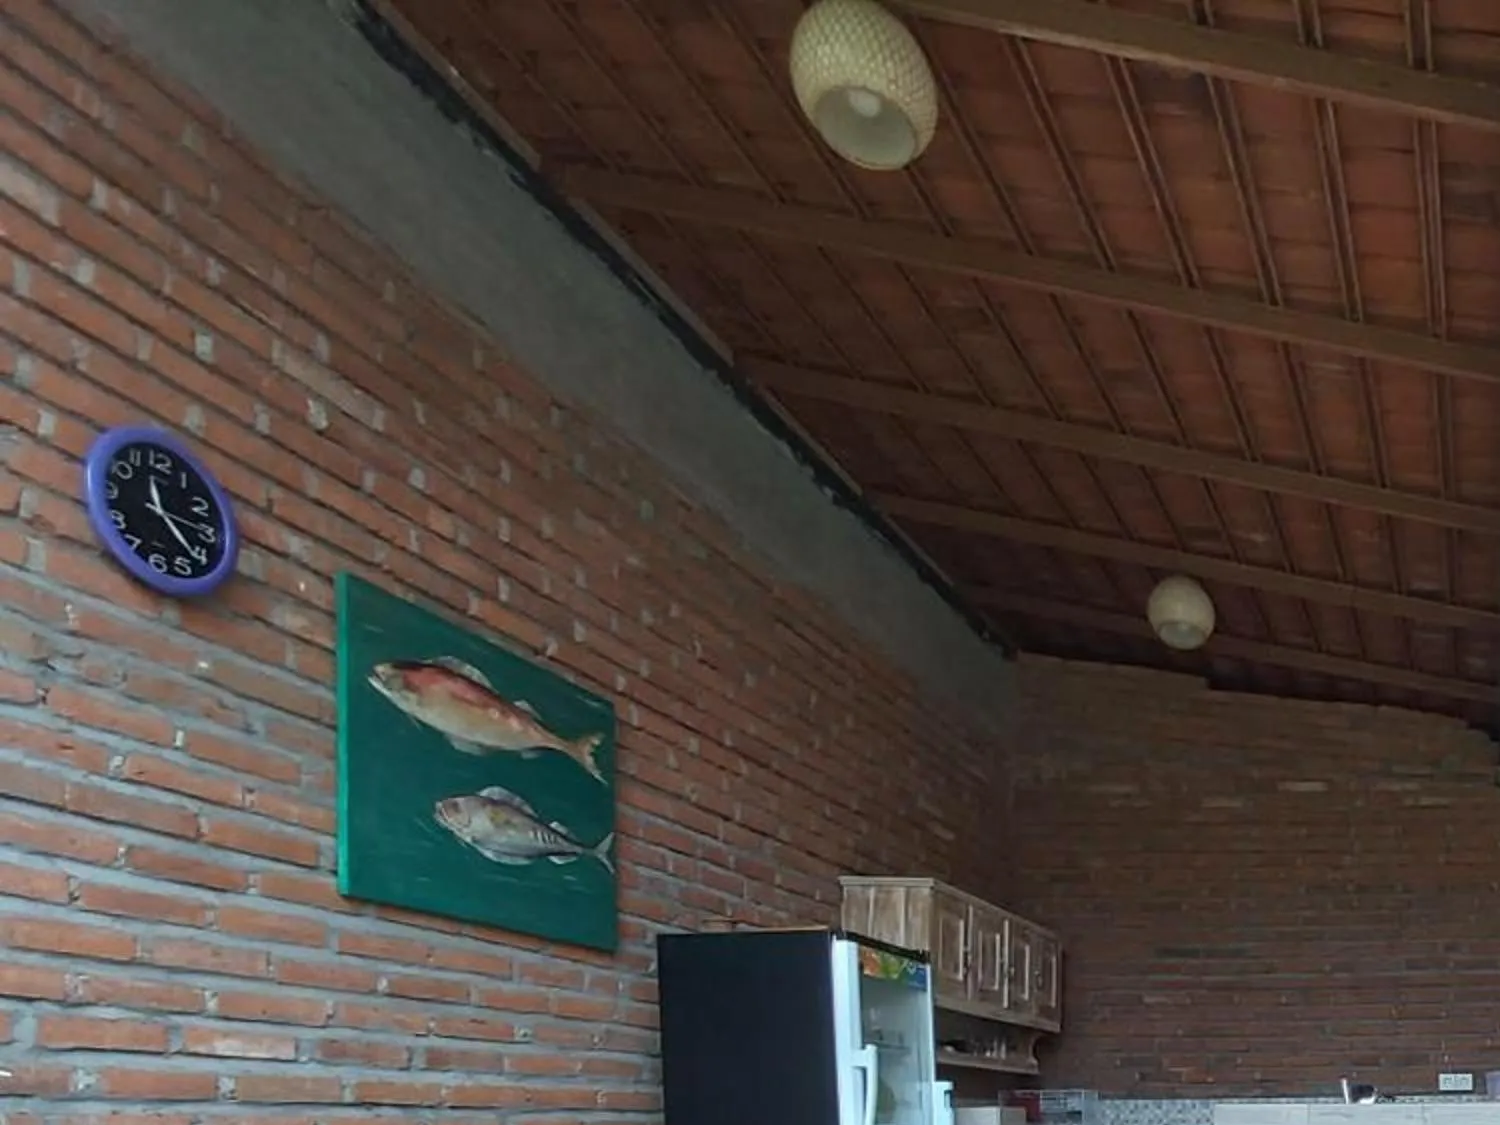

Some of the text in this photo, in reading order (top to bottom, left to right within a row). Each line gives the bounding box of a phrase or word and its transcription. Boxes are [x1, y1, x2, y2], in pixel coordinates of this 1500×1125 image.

[129, 447, 141, 467] 11
[148, 449, 172, 475] 12
[181, 472, 187, 489] 1
[191, 496, 208, 517] 2
[111, 510, 126, 530] 8
[124, 533, 141, 551] 7
[198, 522, 216, 543] 3
[148, 553, 168, 574] 6
[173, 556, 192, 576] 5
[192, 546, 208, 566] 4
